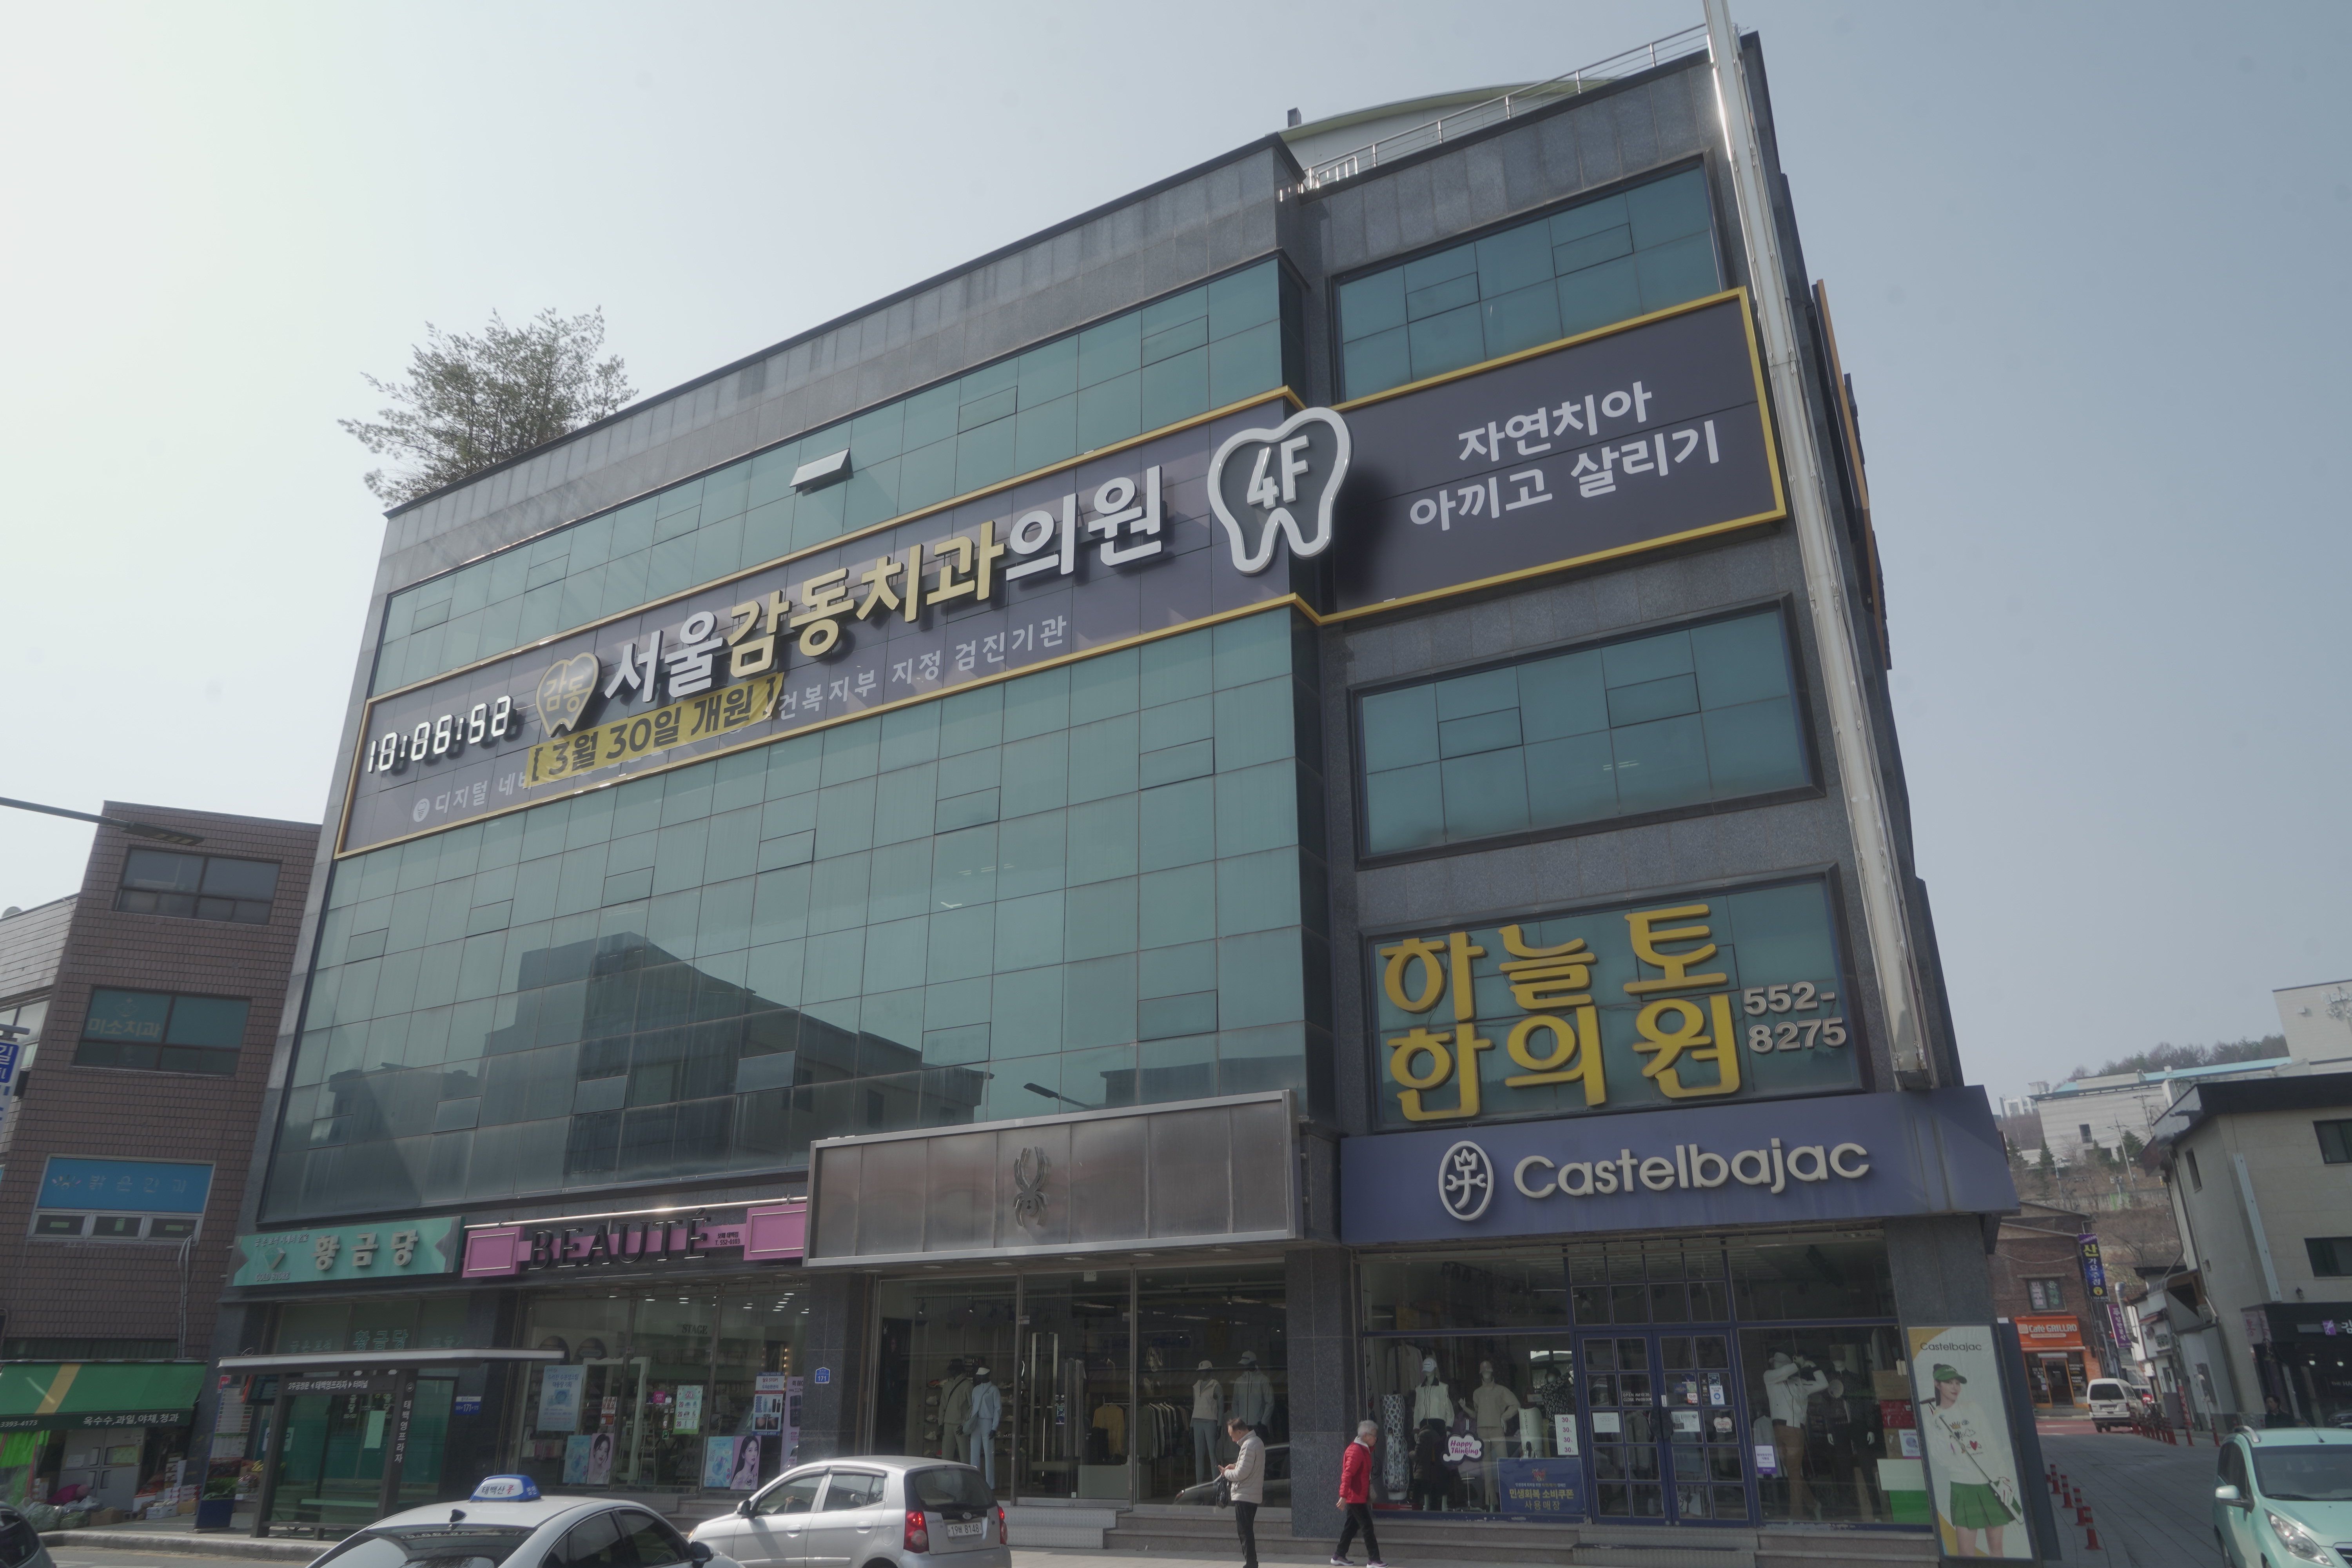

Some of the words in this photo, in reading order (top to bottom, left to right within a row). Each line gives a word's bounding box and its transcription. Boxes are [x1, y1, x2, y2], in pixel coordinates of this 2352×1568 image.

[1458, 381, 1652, 461] 자연치아
[1247, 435, 1309, 509] 4F
[1410, 469, 1553, 530] 아끼고
[1570, 420, 1720, 498] 살리기
[604, 465, 1165, 702] 서울감동치과의원
[778, 669, 876, 720] 건복지부
[892, 650, 940, 684] 지정
[956, 615, 1067, 671] 검진기관
[543, 662, 590, 712] 감동
[548, 731, 599, 775] 3월
[606, 707, 681, 759] 30일
[691, 684, 754, 736] 개원
[434, 780, 488, 814] 디지털
[1744, 981, 1836, 1016] 552-
[88, 1018, 161, 1038] 미소치과
[1748, 1017, 1847, 1054] 8275
[1386, 994, 1742, 1122] 한의원
[1514, 1138, 1870, 1194] Castelbajac
[314, 1229, 418, 1270] 황금당
[528, 1209, 711, 1271] BEAUTÉ
[2083, 1244, 2099, 1257] 산
[353, 1329, 408, 1351] 황금당
[682, 1324, 708, 1334] STAGE
[2028, 1325, 2045, 1333] Café
[1921, 1342, 1982, 1352] Castelbajac
[353, 1379, 369, 1389] 터미널
[0, 1419, 38, 1428] 3393-4173
[463, 1403, 472, 1412] 171
[1509, 1488, 1540, 1499] 민생회복
[1542, 1488, 1574, 1499] 소비쿠폰
[1525, 1500, 1560, 1510] 사용매장
[965, 1524, 979, 1534] 8148
